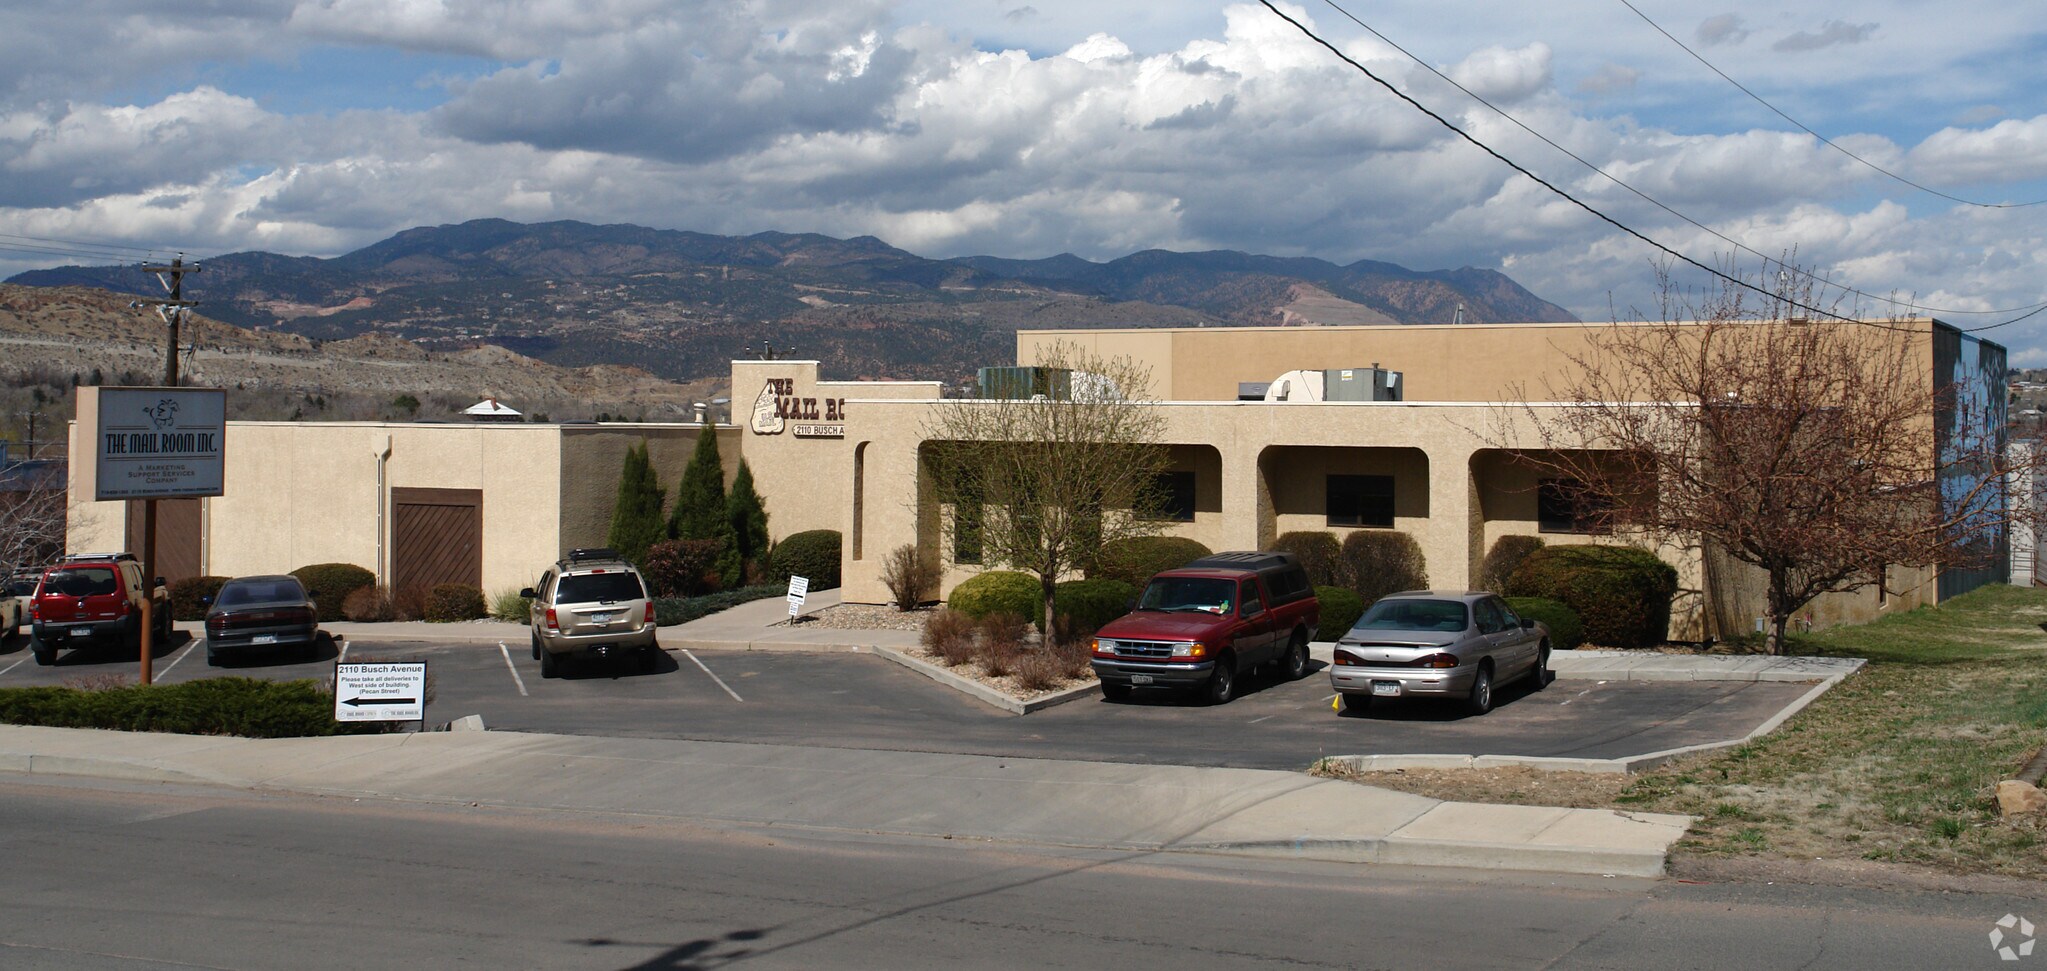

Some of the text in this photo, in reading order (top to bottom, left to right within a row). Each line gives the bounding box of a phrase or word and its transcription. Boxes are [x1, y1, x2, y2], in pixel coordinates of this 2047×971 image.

[767, 378, 793, 395] THE
[774, 397, 819, 420] MAIL
[796, 426, 811, 434] 2110
[814, 426, 838, 435] BUSCH
[106, 432, 217, 454] THE MAIL ROOM INC.
[361, 665, 389, 673] Busch
[390, 665, 422, 673] Avenue
